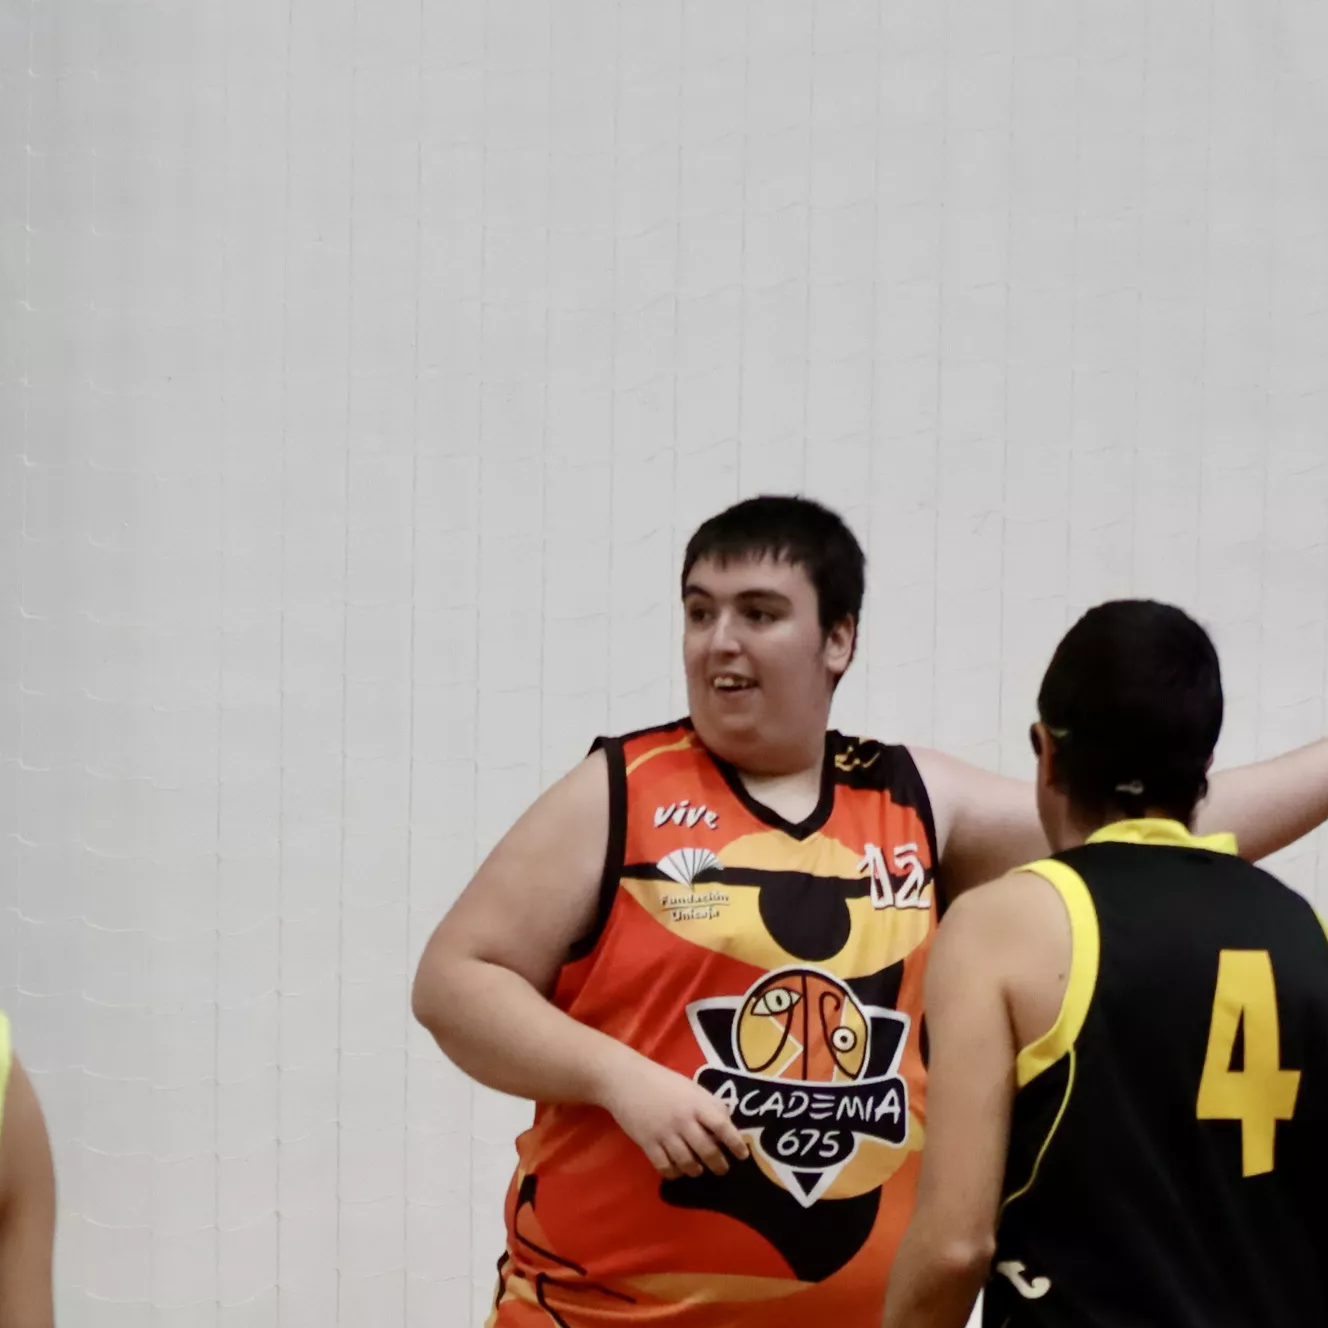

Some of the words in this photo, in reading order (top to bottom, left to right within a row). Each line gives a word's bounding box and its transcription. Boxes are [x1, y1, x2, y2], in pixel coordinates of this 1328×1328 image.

[856, 842, 932, 909] 12
[1196, 948, 1301, 1178] 4
[713, 1078, 902, 1125] ACADEMIA
[776, 1128, 841, 1158] 675
